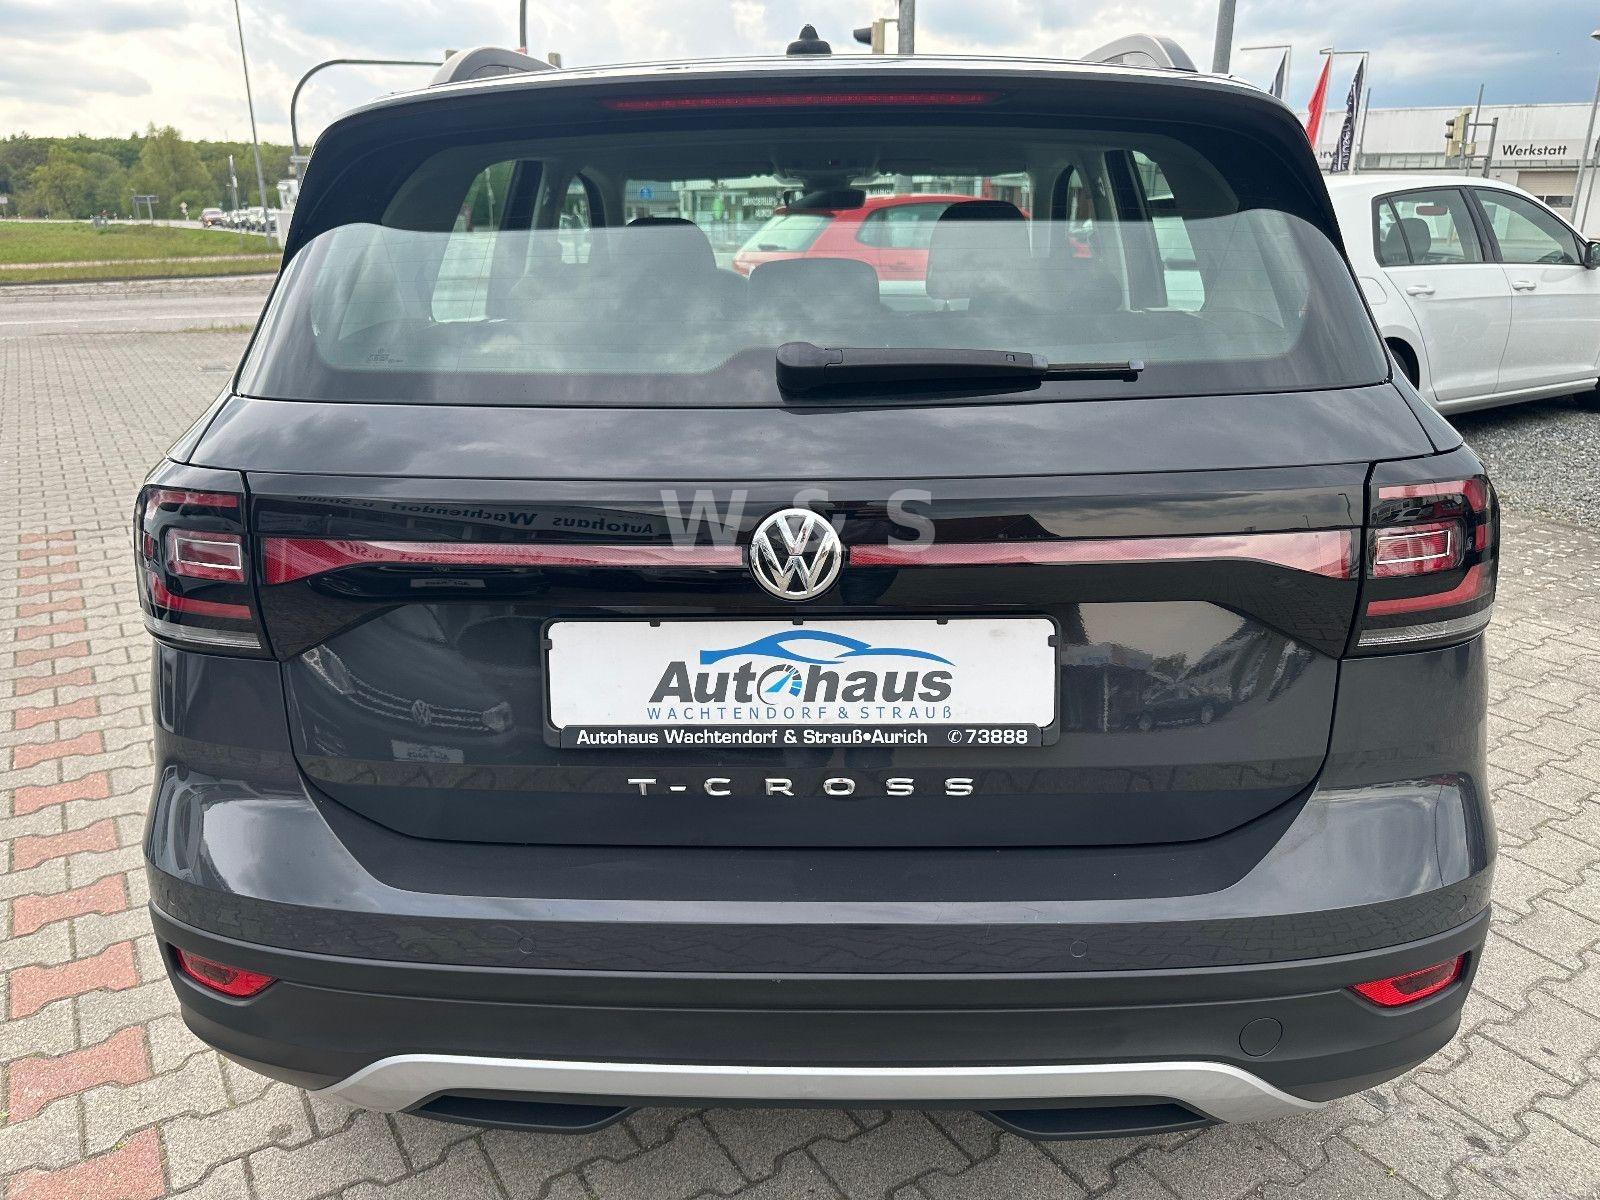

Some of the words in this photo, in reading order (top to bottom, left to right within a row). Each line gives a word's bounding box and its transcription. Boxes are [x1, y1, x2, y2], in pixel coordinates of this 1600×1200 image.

[1502, 144, 1568, 157] Werkstatt
[649, 661, 953, 705] Autohaus
[647, 707, 827, 720] WACHTENDORF
[838, 707, 849, 720] &
[576, 729, 659, 745] Autohaus
[664, 729, 778, 745] Wachtendorf
[784, 729, 798, 745] &
[966, 730, 1028, 745] 73888
[628, 778, 975, 797] T-CROSS
